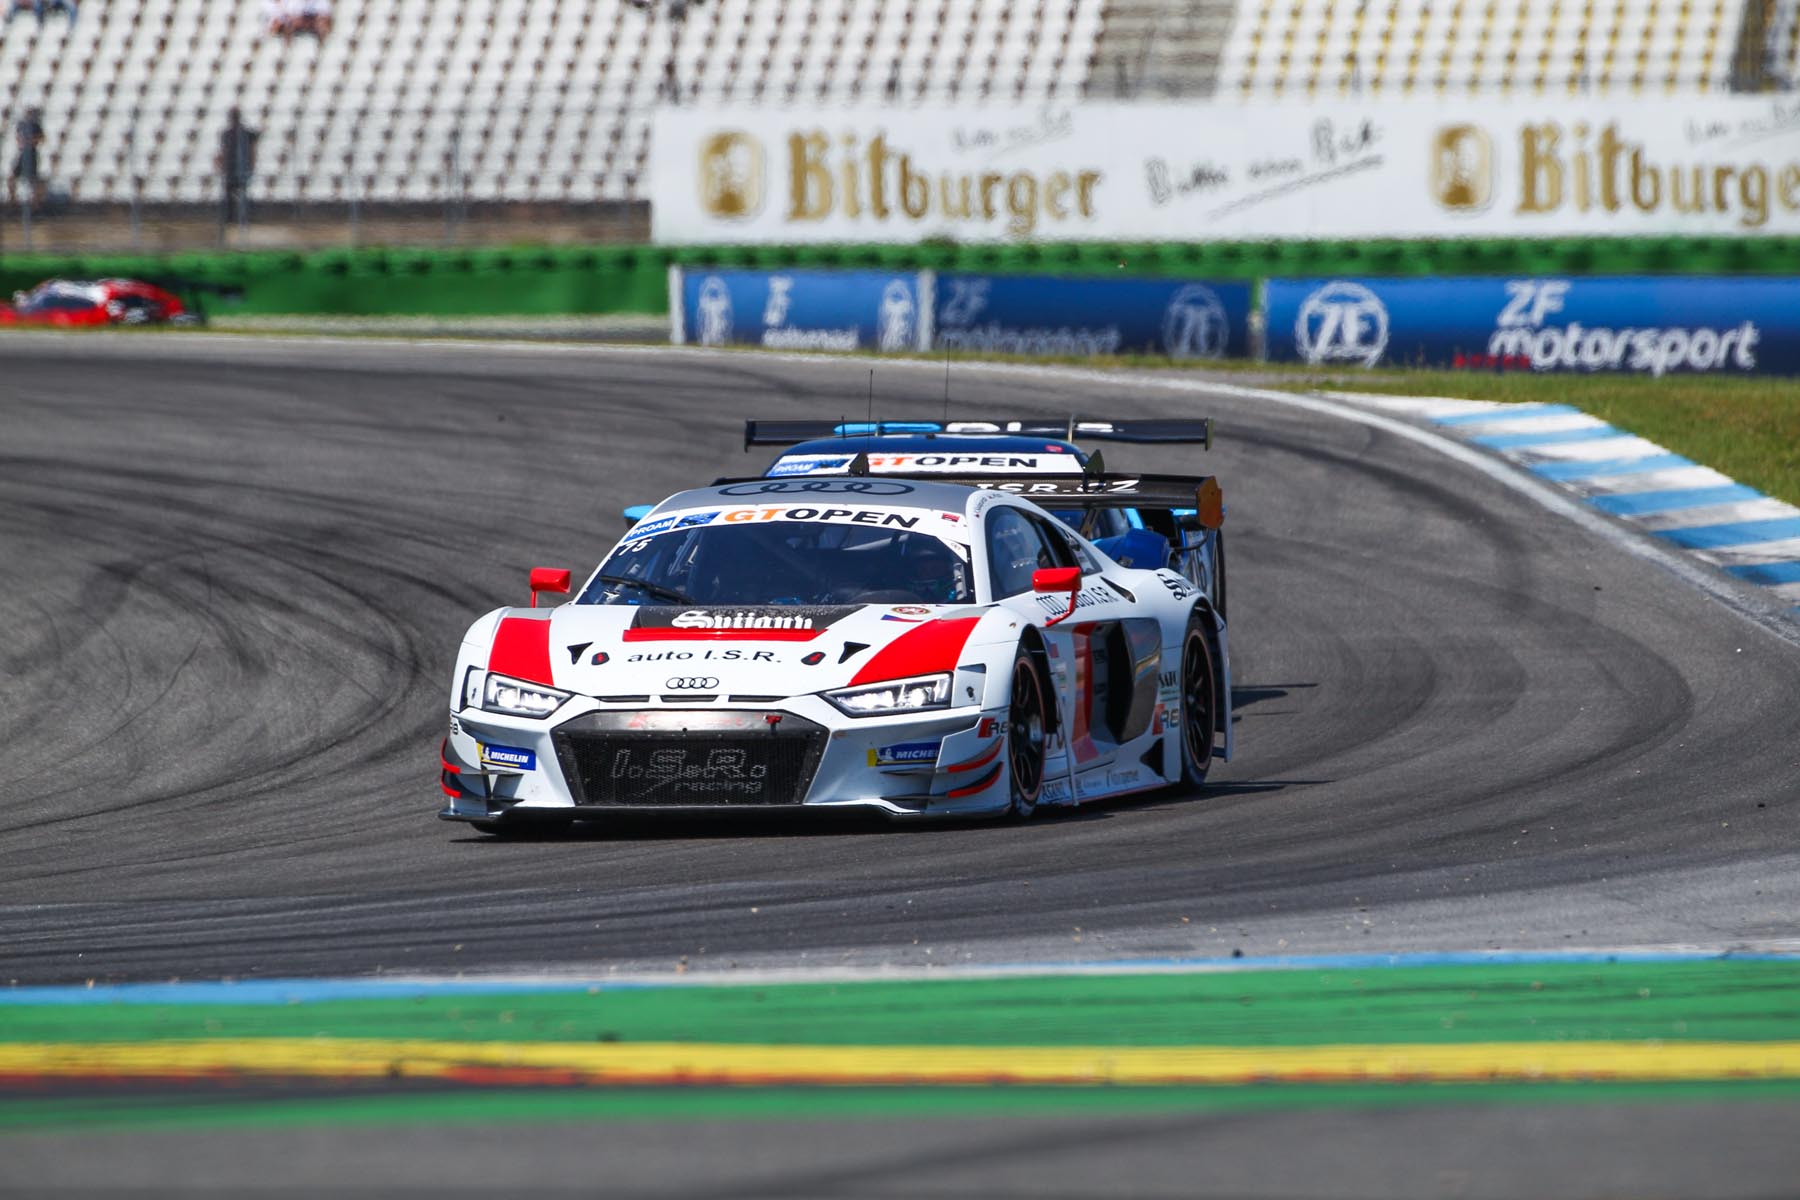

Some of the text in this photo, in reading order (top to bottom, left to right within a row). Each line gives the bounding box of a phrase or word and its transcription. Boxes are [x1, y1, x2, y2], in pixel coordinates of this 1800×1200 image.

[786, 128, 1101, 236] Bitburger
[1497, 280, 1573, 327] ZF
[1488, 320, 1760, 378] motorsport
[629, 519, 673, 537] PROAM
[618, 538, 652, 557] 75
[627, 649, 782, 663] auto I.S.R.
[490, 751, 529, 763] MICHELIN
